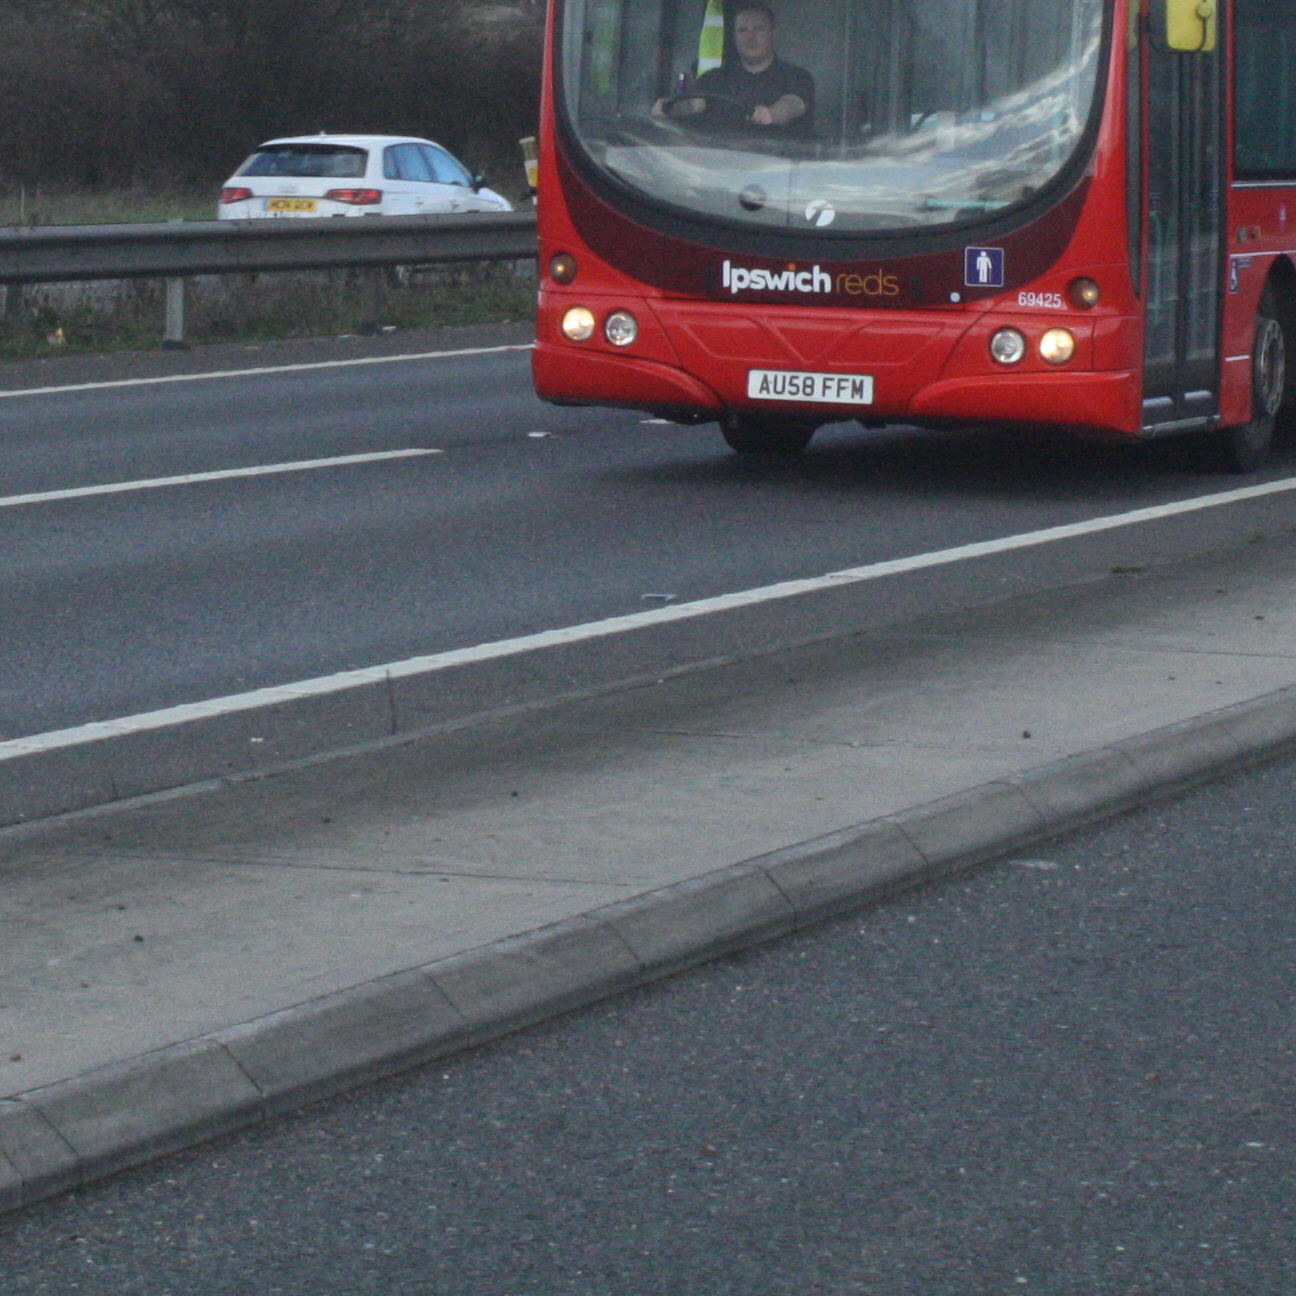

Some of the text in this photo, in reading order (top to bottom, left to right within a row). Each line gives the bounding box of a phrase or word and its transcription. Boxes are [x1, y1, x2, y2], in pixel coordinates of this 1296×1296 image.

[722, 259, 900, 296] Ipswich reds
[1017, 291, 1062, 309] 69425
[758, 373, 865, 400] AU58 FFM
